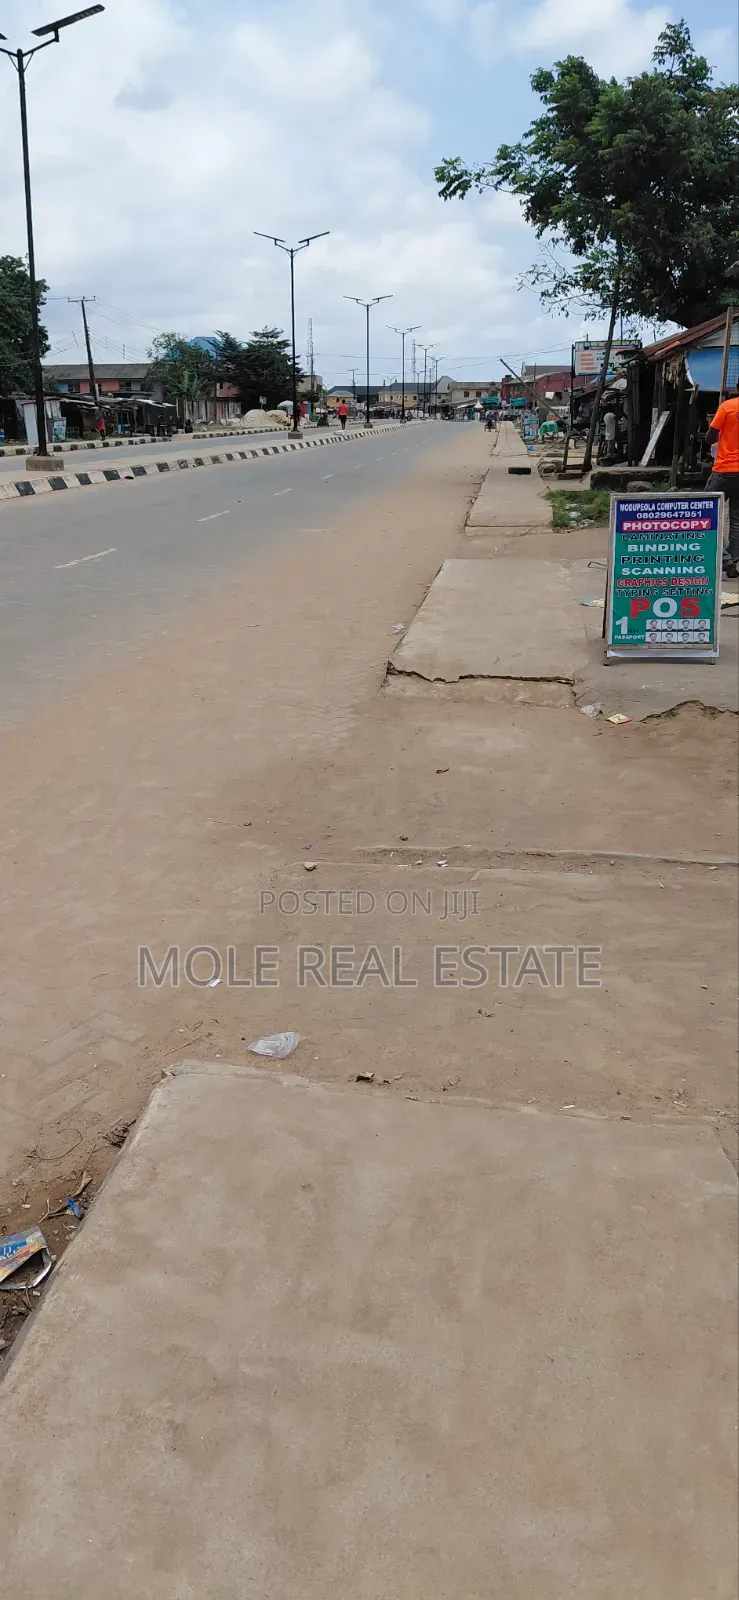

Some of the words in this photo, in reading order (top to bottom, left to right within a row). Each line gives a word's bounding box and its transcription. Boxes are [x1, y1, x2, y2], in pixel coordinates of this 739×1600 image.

[657, 501, 689, 511] COMPUTER
[690, 501, 713, 509] CENTER
[636, 511, 702, 519] 08029647951
[623, 520, 709, 530] PHOTOCOPY
[622, 532, 705, 541] LAMINATING
[627, 543, 701, 552] BINDING
[621, 555, 704, 564] PRINTING
[621, 566, 705, 575] SCANNING
[617, 577, 668, 586] GRAPHICS
[670, 577, 709, 585] DESIGN
[616, 589, 659, 597] TYPING
[662, 588, 713, 596] SETTING
[630, 597, 701, 618] POS
[615, 616, 628, 634] 1
